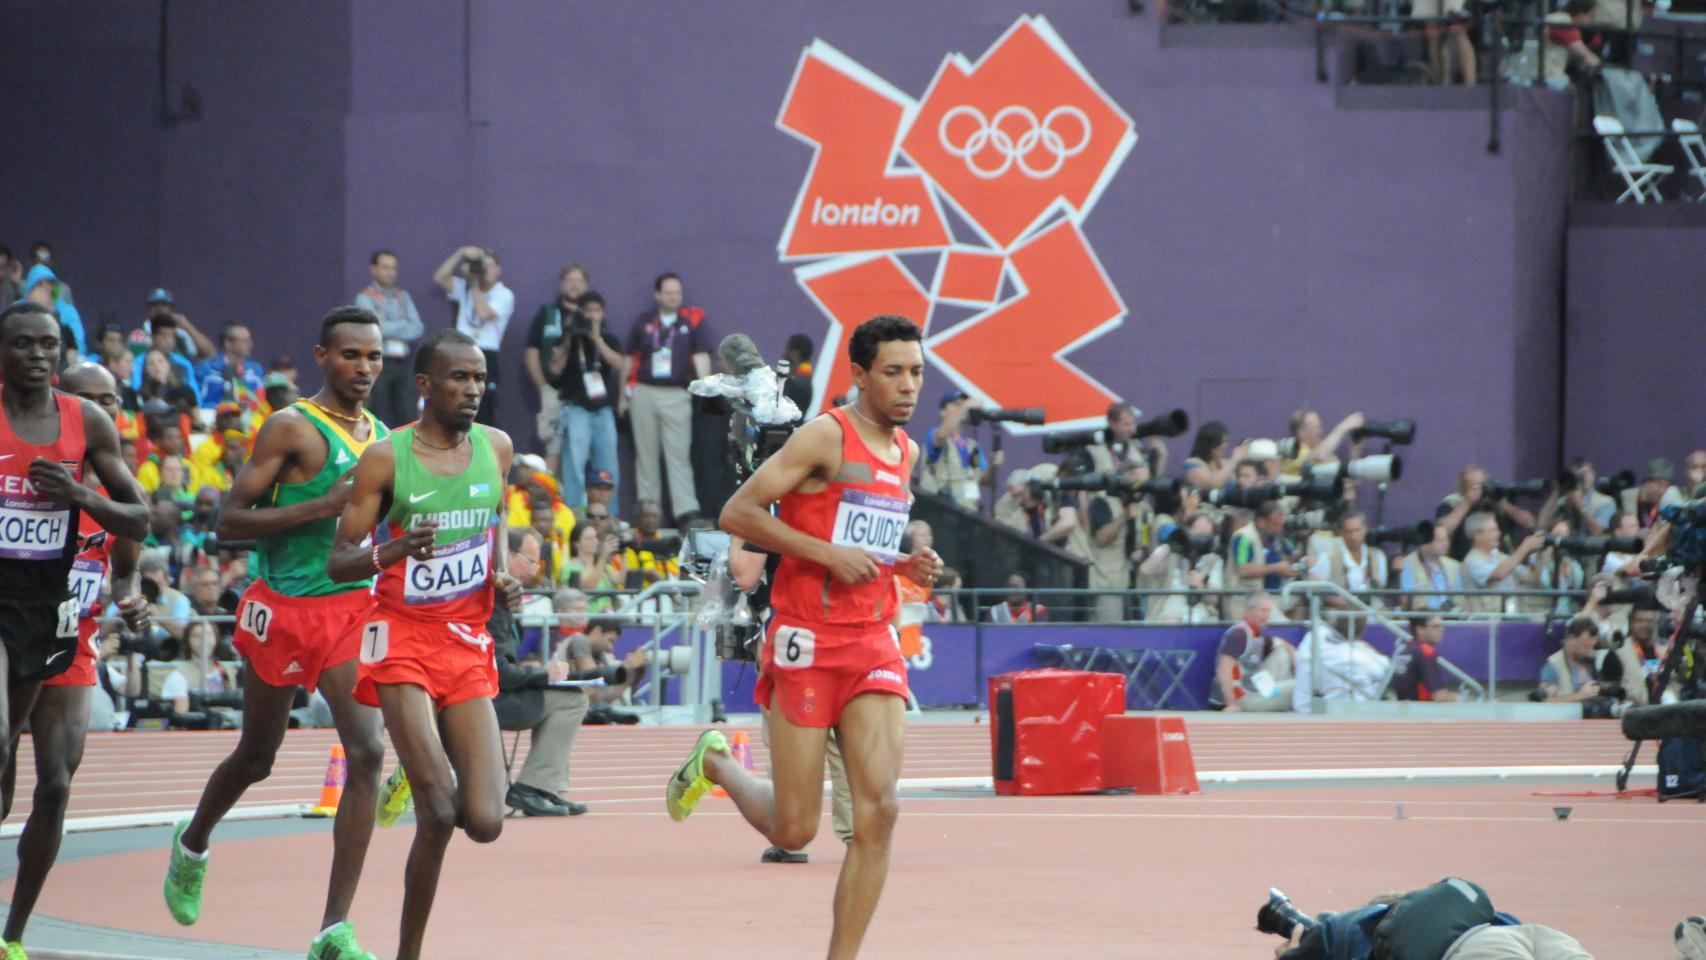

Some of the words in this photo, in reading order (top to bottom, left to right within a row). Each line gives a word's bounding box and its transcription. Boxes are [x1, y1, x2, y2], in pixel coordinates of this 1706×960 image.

[811, 196, 920, 225] london
[843, 510, 904, 549] IGUIDE
[411, 554, 484, 591] GALA
[248, 602, 266, 637] 10
[368, 626, 378, 658] 7
[786, 631, 800, 662] 6
